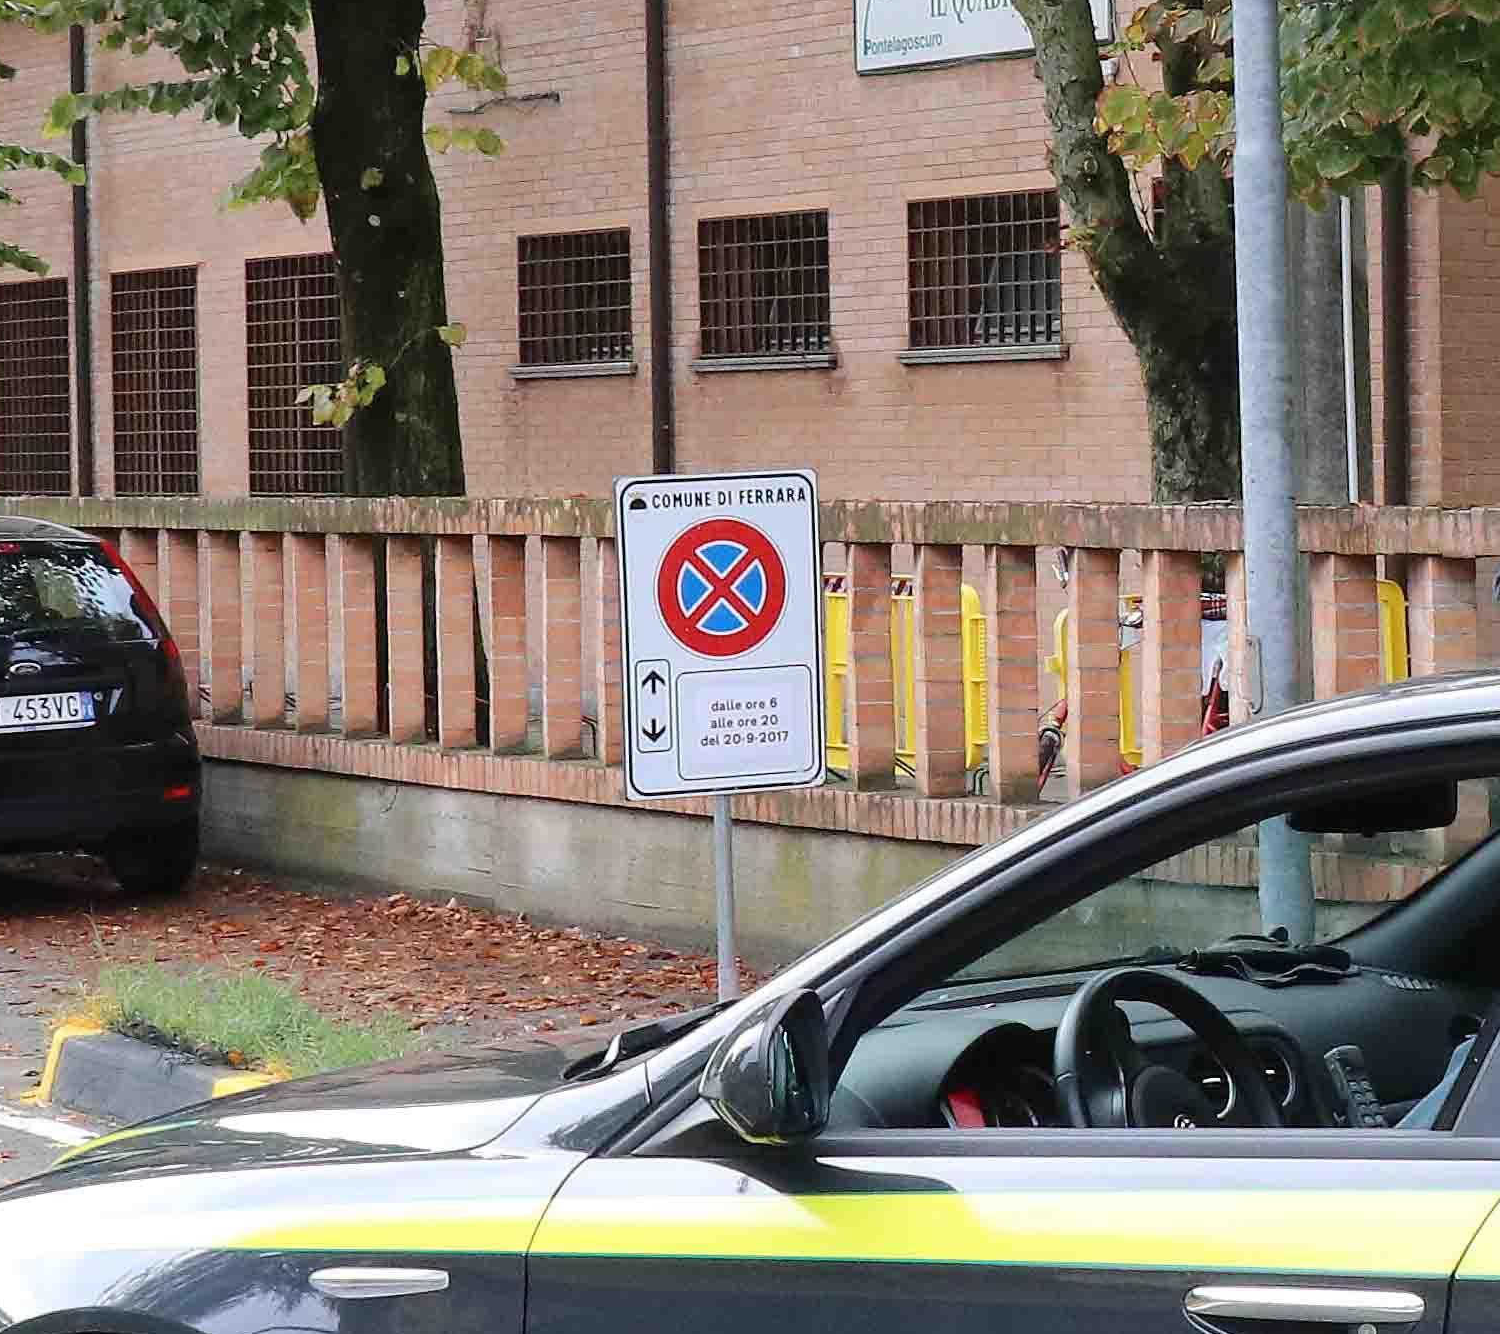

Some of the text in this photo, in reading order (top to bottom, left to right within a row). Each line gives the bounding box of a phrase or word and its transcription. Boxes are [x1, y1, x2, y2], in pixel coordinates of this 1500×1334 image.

[864, 33, 943, 55] Pontelagoscuro
[651, 487, 806, 509] COMUNE DI FERRARA
[12, 695, 79, 722] 453VG
[710, 697, 778, 712] dalle ore 6
[710, 714, 779, 729] alle ore 20
[701, 734, 720, 746] del
